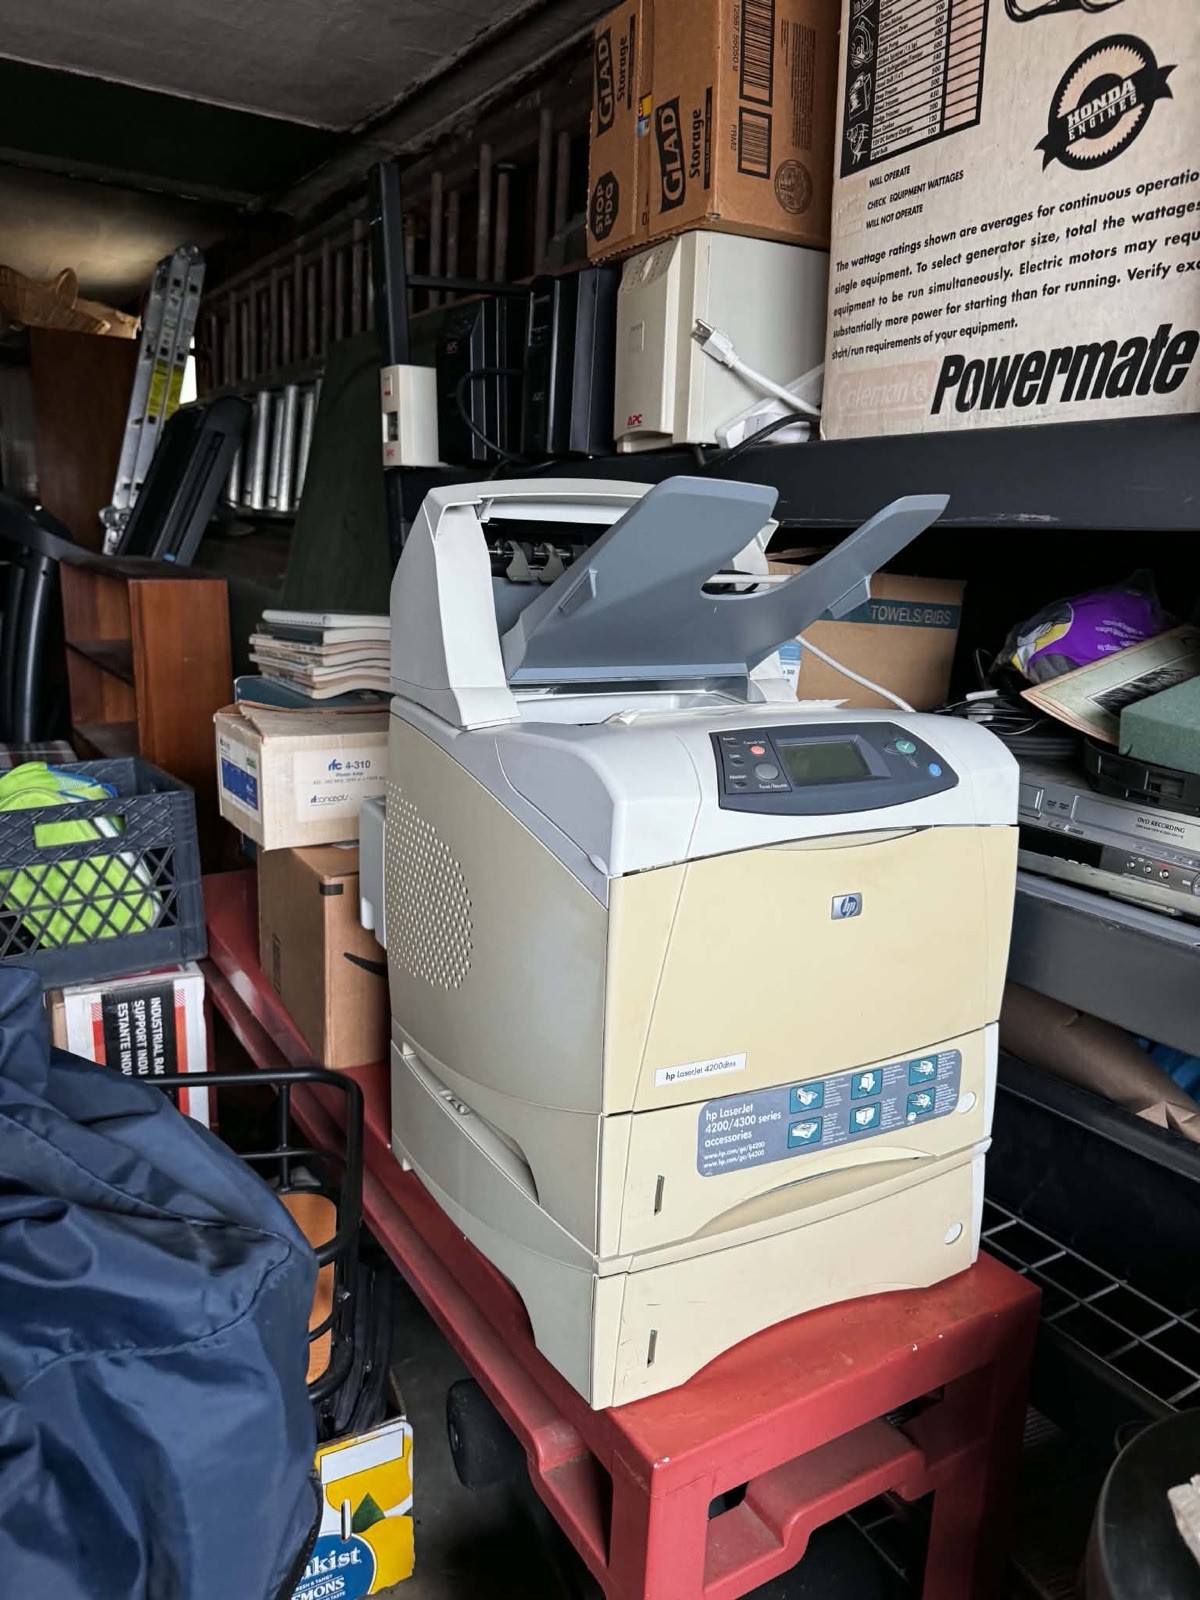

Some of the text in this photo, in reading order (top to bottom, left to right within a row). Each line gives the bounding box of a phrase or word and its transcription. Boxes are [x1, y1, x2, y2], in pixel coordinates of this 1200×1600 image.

[599, 39, 612, 124] GLAD
[617, 38, 628, 102] Storage
[1067, 78, 1136, 128] HONDA
[1069, 93, 1137, 141] ENGINES
[661, 107, 683, 200] GLAD
[689, 108, 704, 179] Storage
[867, 170, 964, 210] CHECK EQUIPMENT WATTAGES
[869, 165, 911, 188] WILL OPERATE
[836, 169, 1200, 273] The wattage ratings shown are averages for continuous operatio
[866, 204, 923, 230] WILL NOT OPERATE
[834, 201, 1200, 295] single equipment. To select generator size, total the wattages
[833, 296, 875, 317] equipment
[879, 295, 888, 306] to
[892, 291, 903, 303] be
[907, 289, 924, 299] run
[928, 267, 1013, 295] simultaneously.
[1019, 256, 1063, 275] Electric
[1069, 245, 1117, 264] motors
[1124, 238, 1158, 254] may
[833, 318, 882, 339] substantially
[885, 315, 908, 327] more
[911, 308, 942, 325] power
[946, 303, 961, 316] for
[964, 295, 1007, 312] starting
[1011, 289, 1038, 303] than
[1042, 283, 1061, 297] for
[1065, 274, 1121, 293] running.
[1127, 262, 1171, 282] Verify
[865, 335, 921, 356] requirements
[923, 330, 933, 343] of
[934, 328, 958, 344] your
[959, 317, 1018, 339] equipment.
[930, 323, 1200, 415] Powermate
[626, 414, 643, 426] APC
[870, 605, 951, 625] TOWELS/BIBS
[345, 760, 371, 770] 4-310
[1137, 817, 1150, 826] DVD
[1151, 820, 1186, 833] RECORDING
[117, 1002, 131, 1050] ESTANTE
[134, 999, 147, 1047] SUPPORT
[150, 997, 163, 1057] INDUSTRIAL
[666, 1072, 675, 1081] hp
[705, 1111, 781, 1133] 4200/4300 series
[706, 1103, 753, 1122] hp LaserJet
[705, 1130, 753, 1147] accessories
